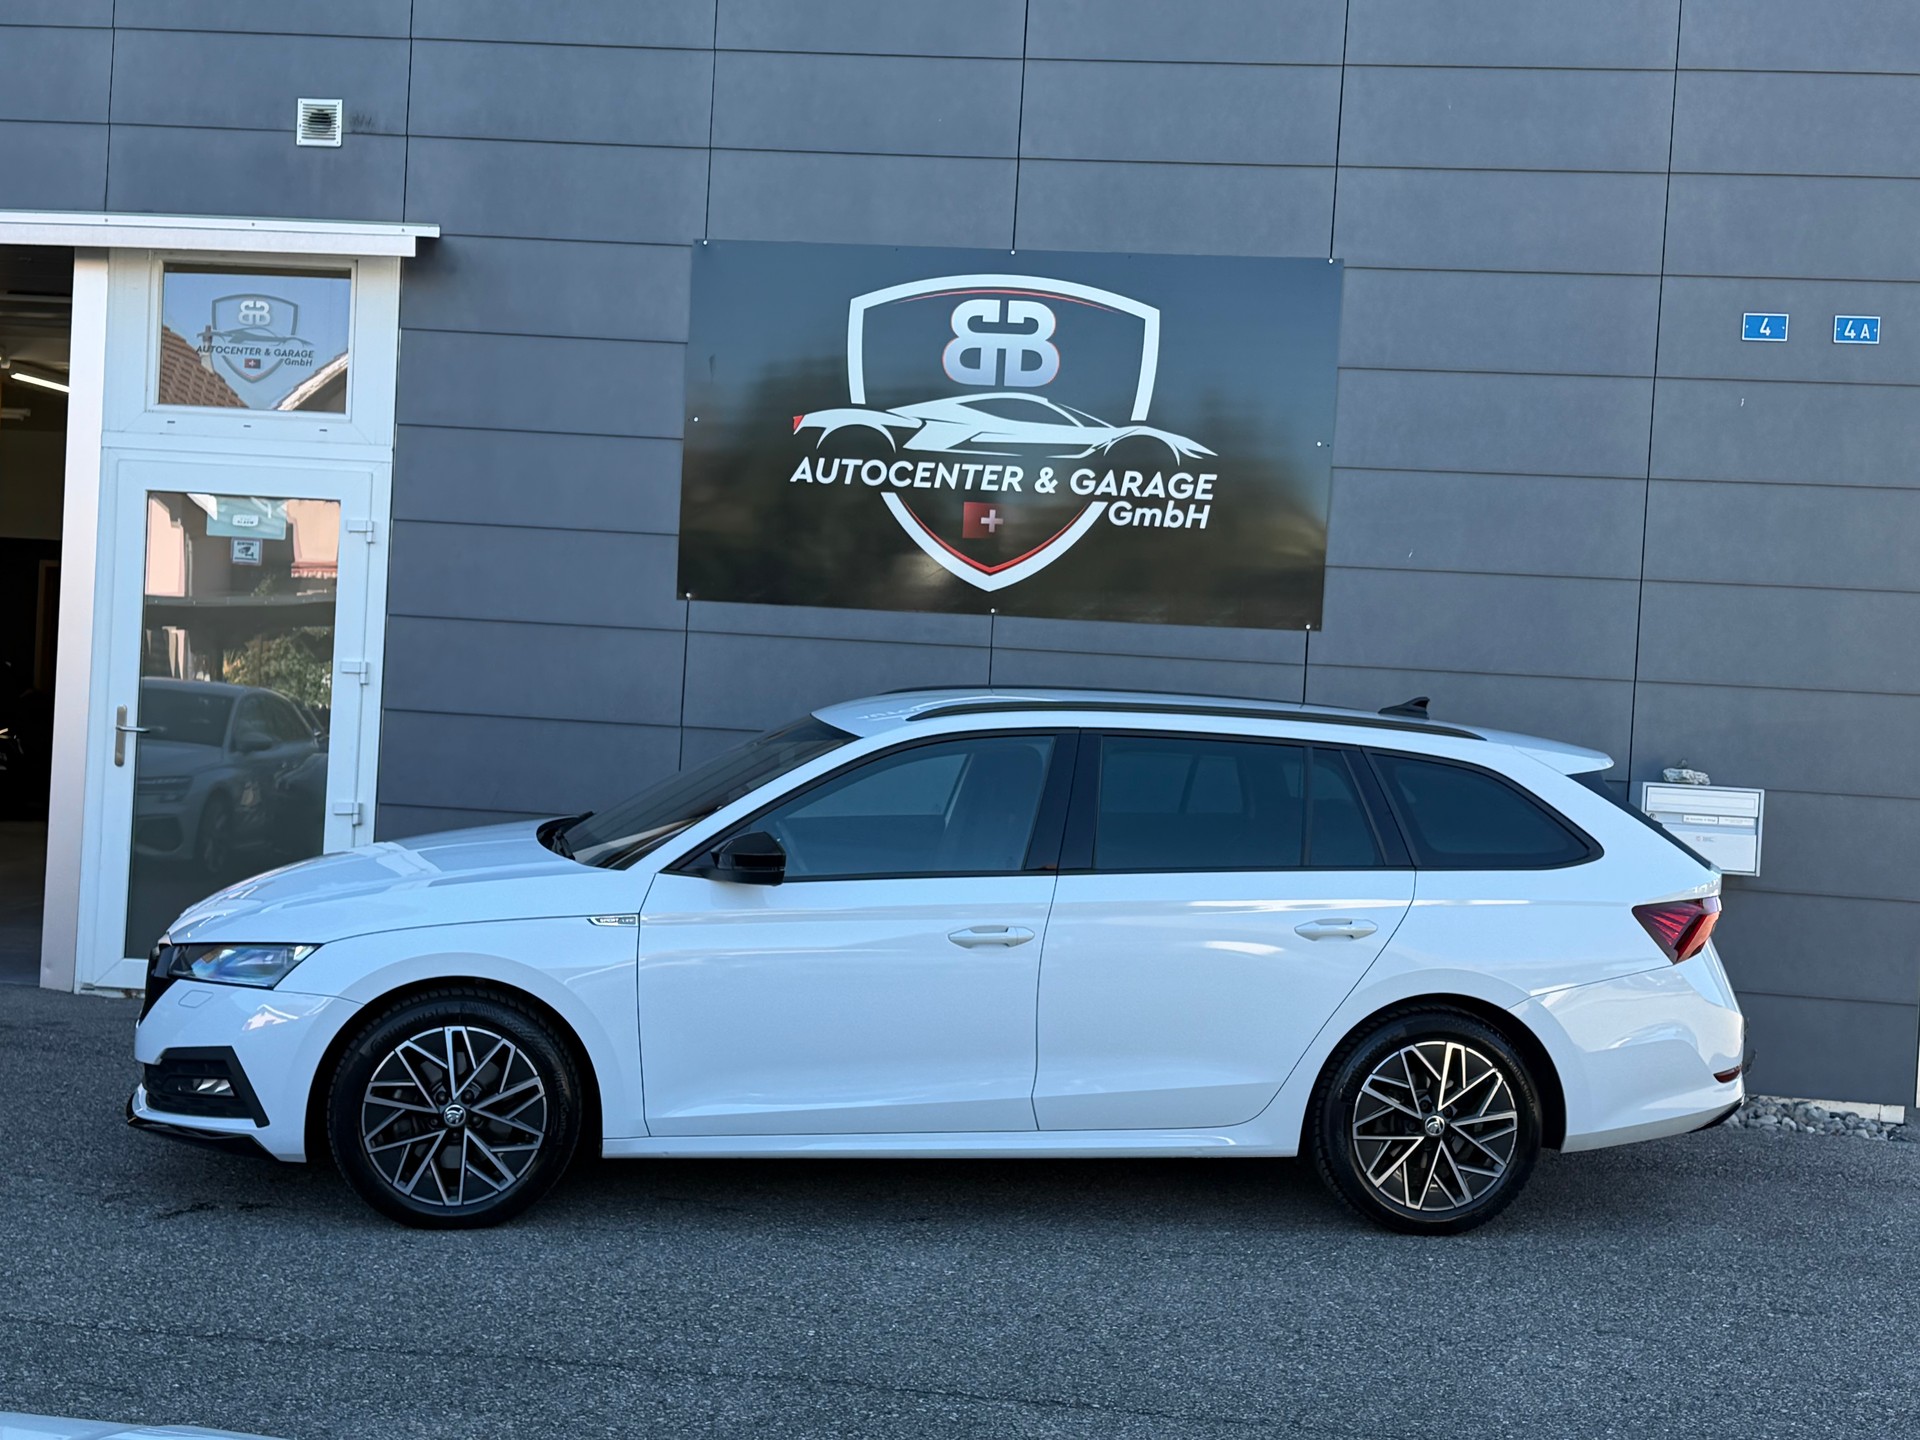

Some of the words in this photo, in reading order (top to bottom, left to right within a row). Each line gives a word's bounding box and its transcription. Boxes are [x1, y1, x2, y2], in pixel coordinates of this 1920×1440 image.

[1759, 317, 1771, 336] 4
[1844, 320, 1870, 340] 4A
[196, 345, 261, 356] AUTOCENTER
[264, 348, 271, 356] &
[274, 349, 314, 358] GARAGE
[284, 358, 312, 367] GmbH
[790, 456, 1024, 492] AUTOCENTER
[1034, 467, 1058, 494] &
[1070, 468, 1218, 500] GARAGE
[1108, 500, 1211, 529] GmbH
